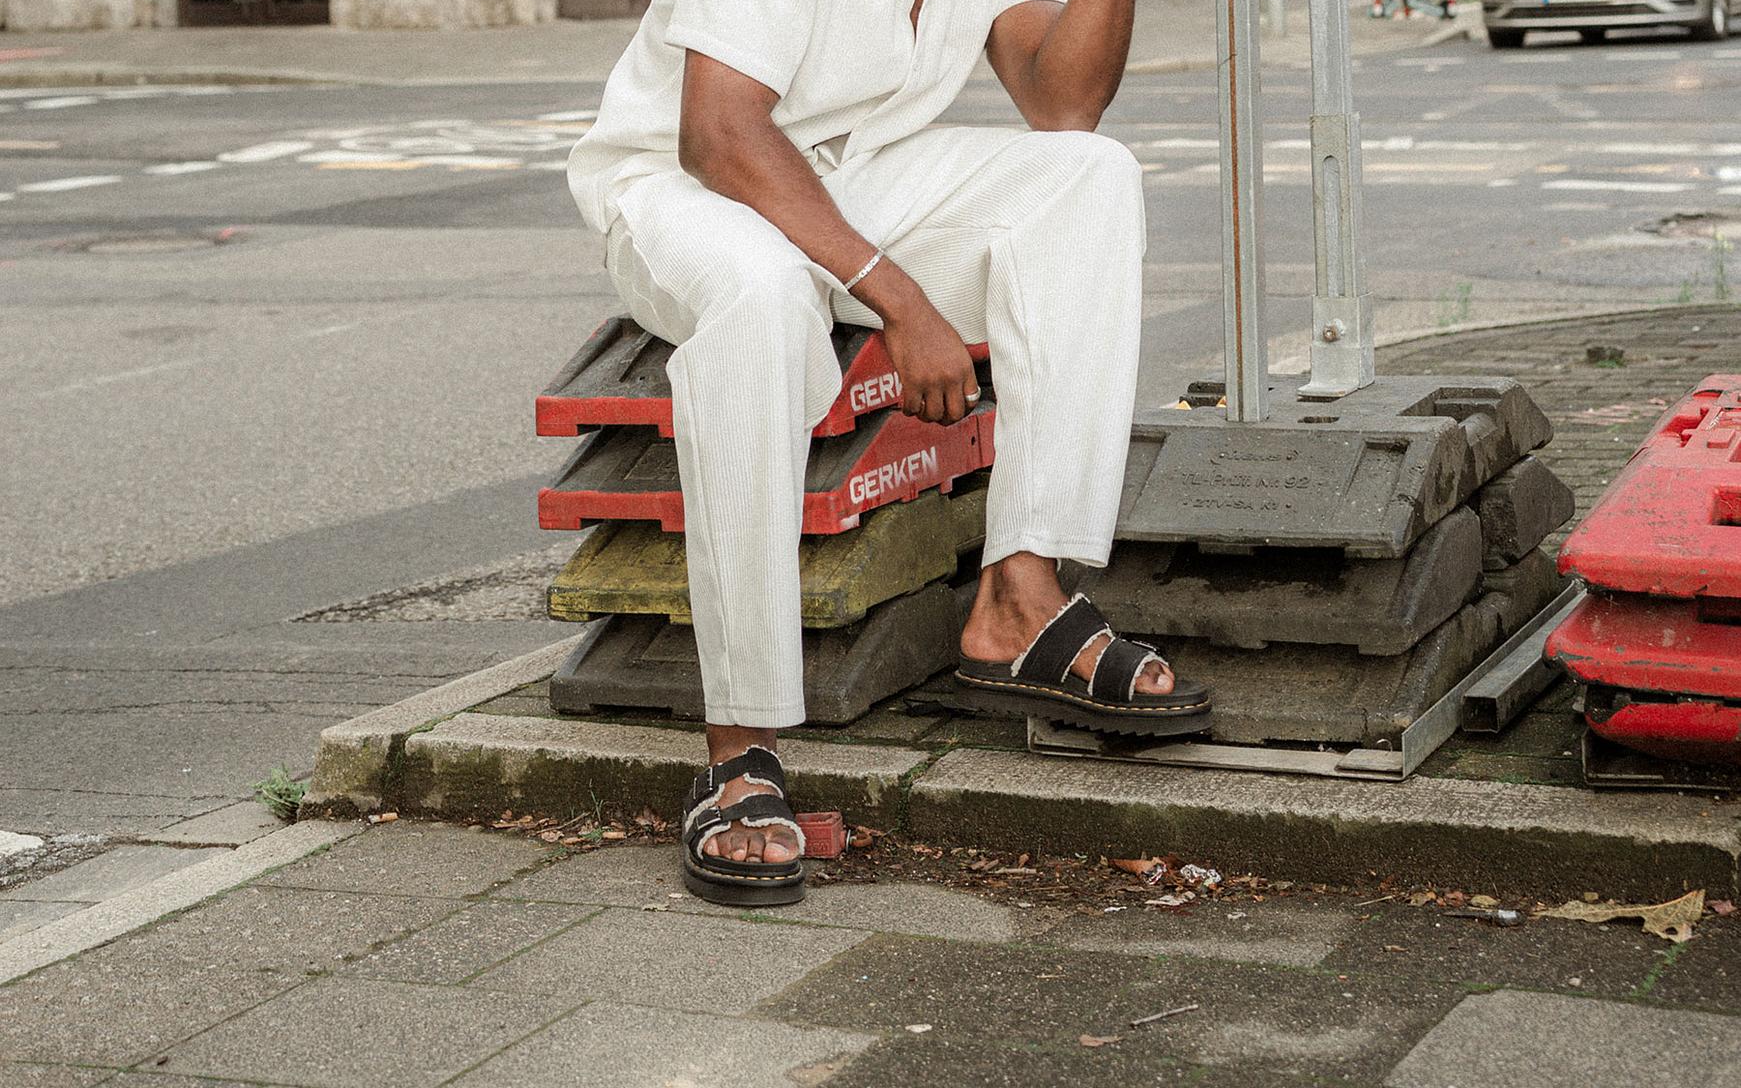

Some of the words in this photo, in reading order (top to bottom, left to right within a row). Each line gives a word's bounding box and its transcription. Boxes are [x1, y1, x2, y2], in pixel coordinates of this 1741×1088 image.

[850, 371, 902, 411] GER
[849, 446, 938, 504] GERKEN
[1284, 475, 1311, 489] 92
